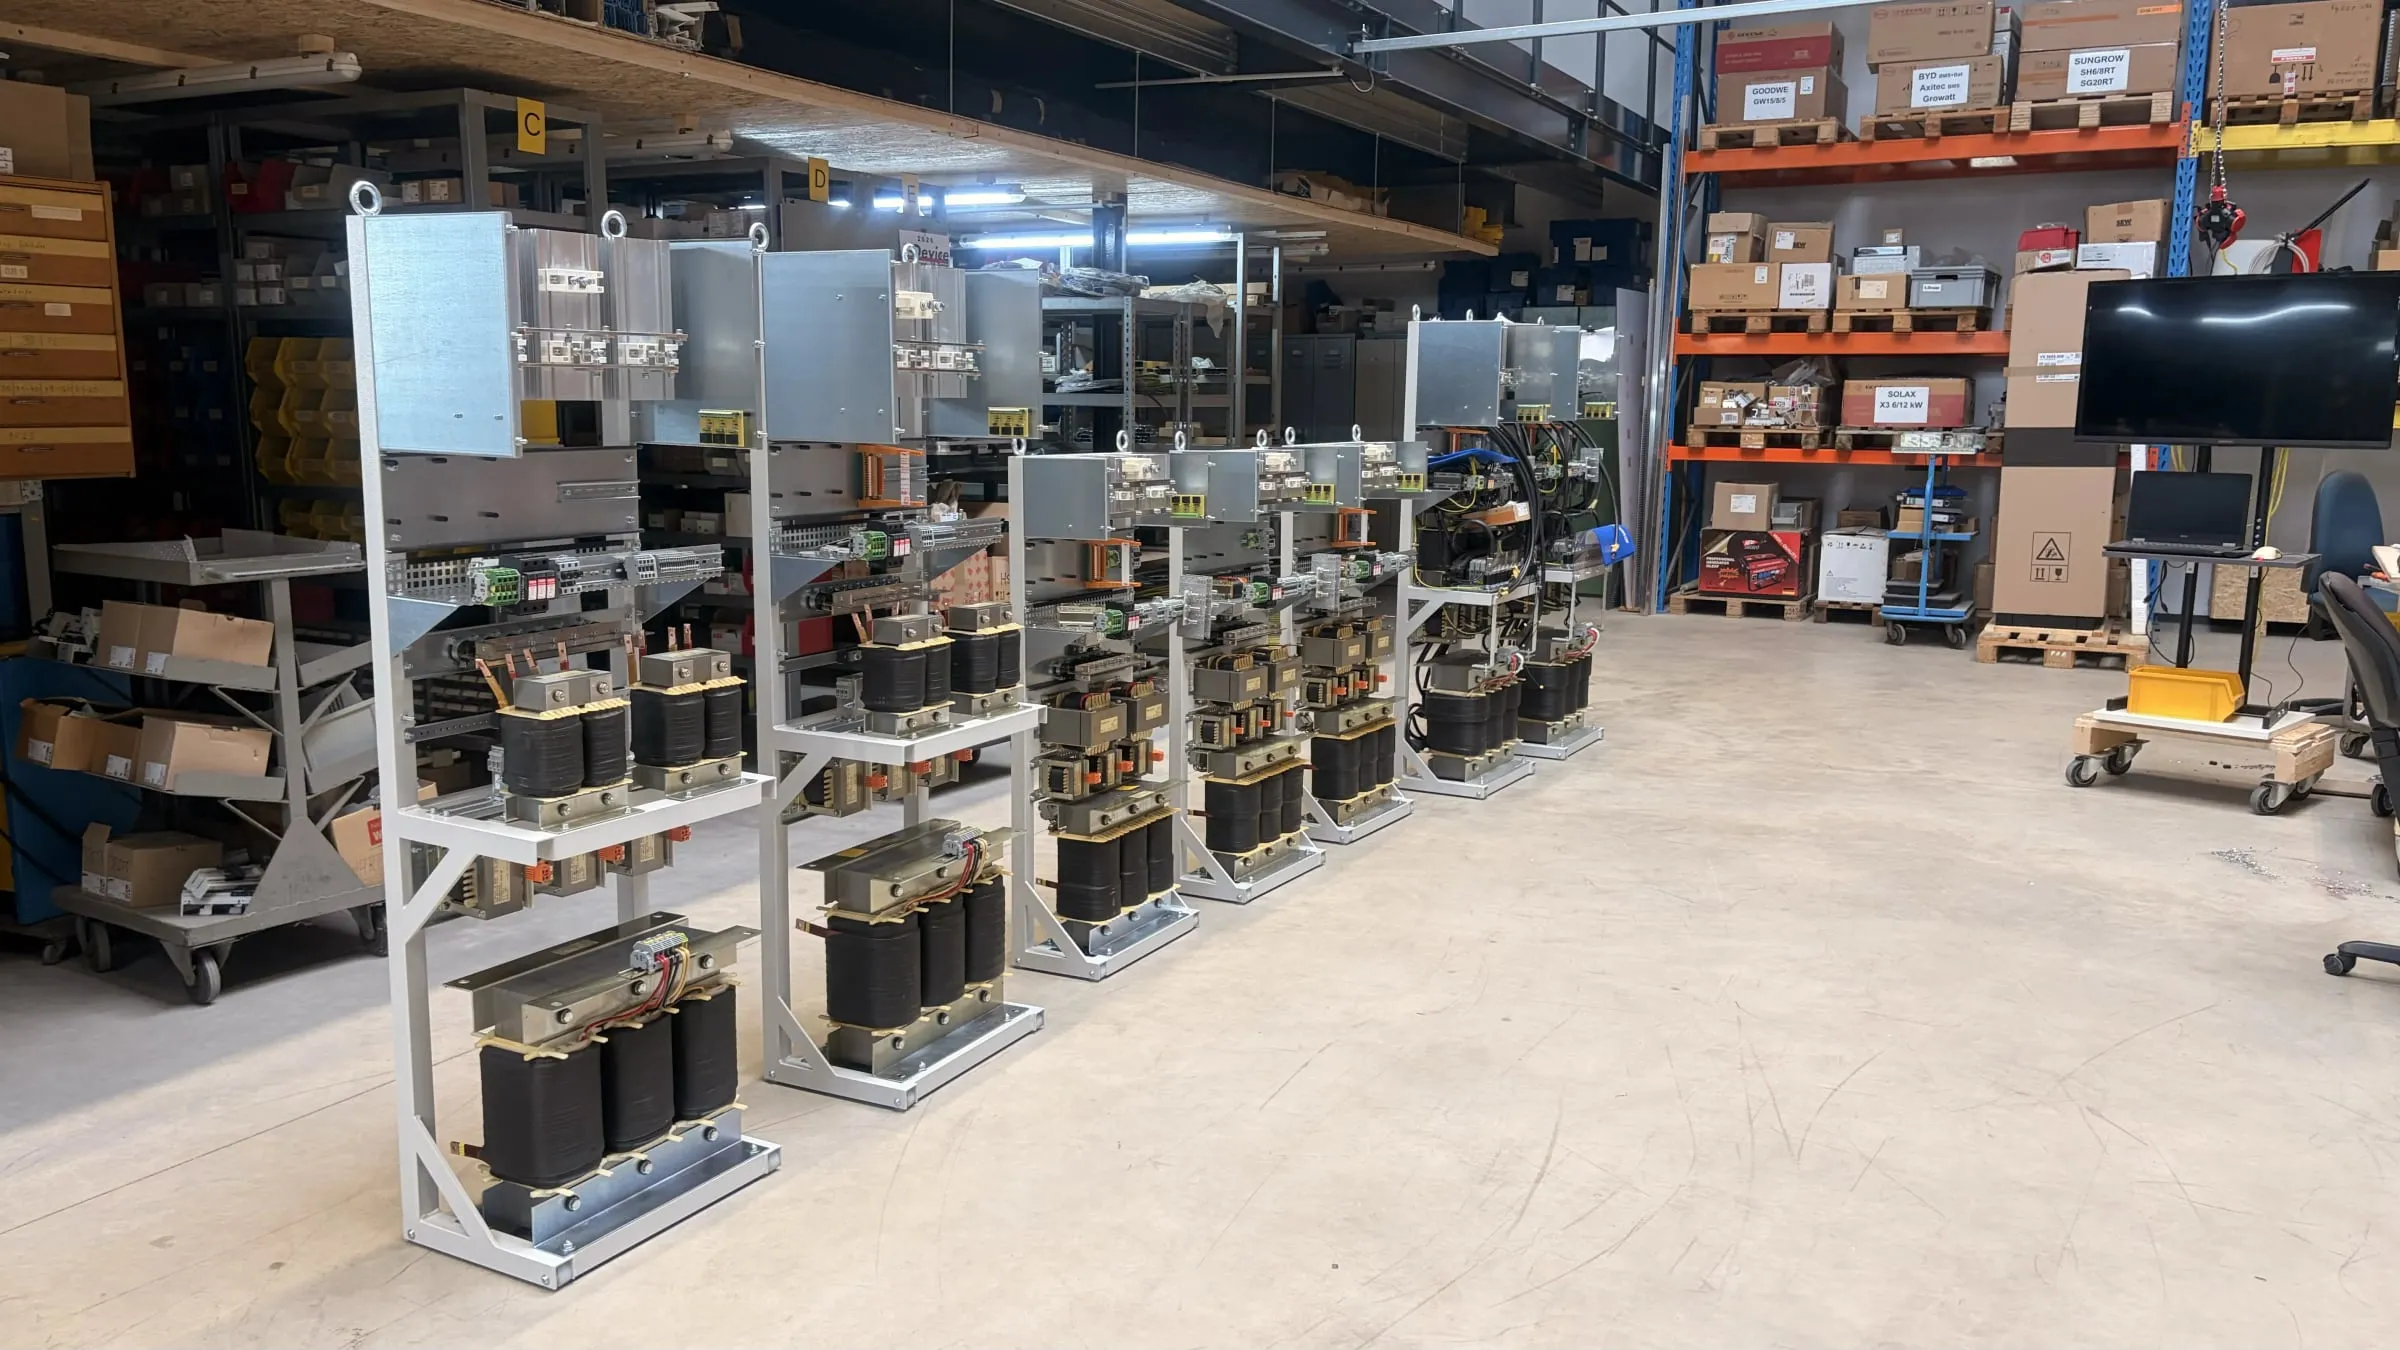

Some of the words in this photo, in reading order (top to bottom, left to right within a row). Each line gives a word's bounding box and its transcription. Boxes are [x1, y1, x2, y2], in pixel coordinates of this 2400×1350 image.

[2074, 54, 2125, 66] SUNGROW
[1918, 72, 1937, 80] BYD
[2080, 66, 2117, 76] SH6/8RT
[2080, 77, 2115, 87] SG20RT
[1752, 86, 1789, 95] GOODWE
[1920, 83, 1946, 92] Axitec
[1922, 93, 1956, 103] Growatt
[525, 112, 540, 136] C
[815, 169, 826, 188] D
[907, 184, 916, 203] E
[1887, 390, 1917, 398] SOLAX
[1879, 401, 1890, 409] X3
[1891, 401, 1908, 409] 6/12
[1910, 401, 1923, 409] kW
